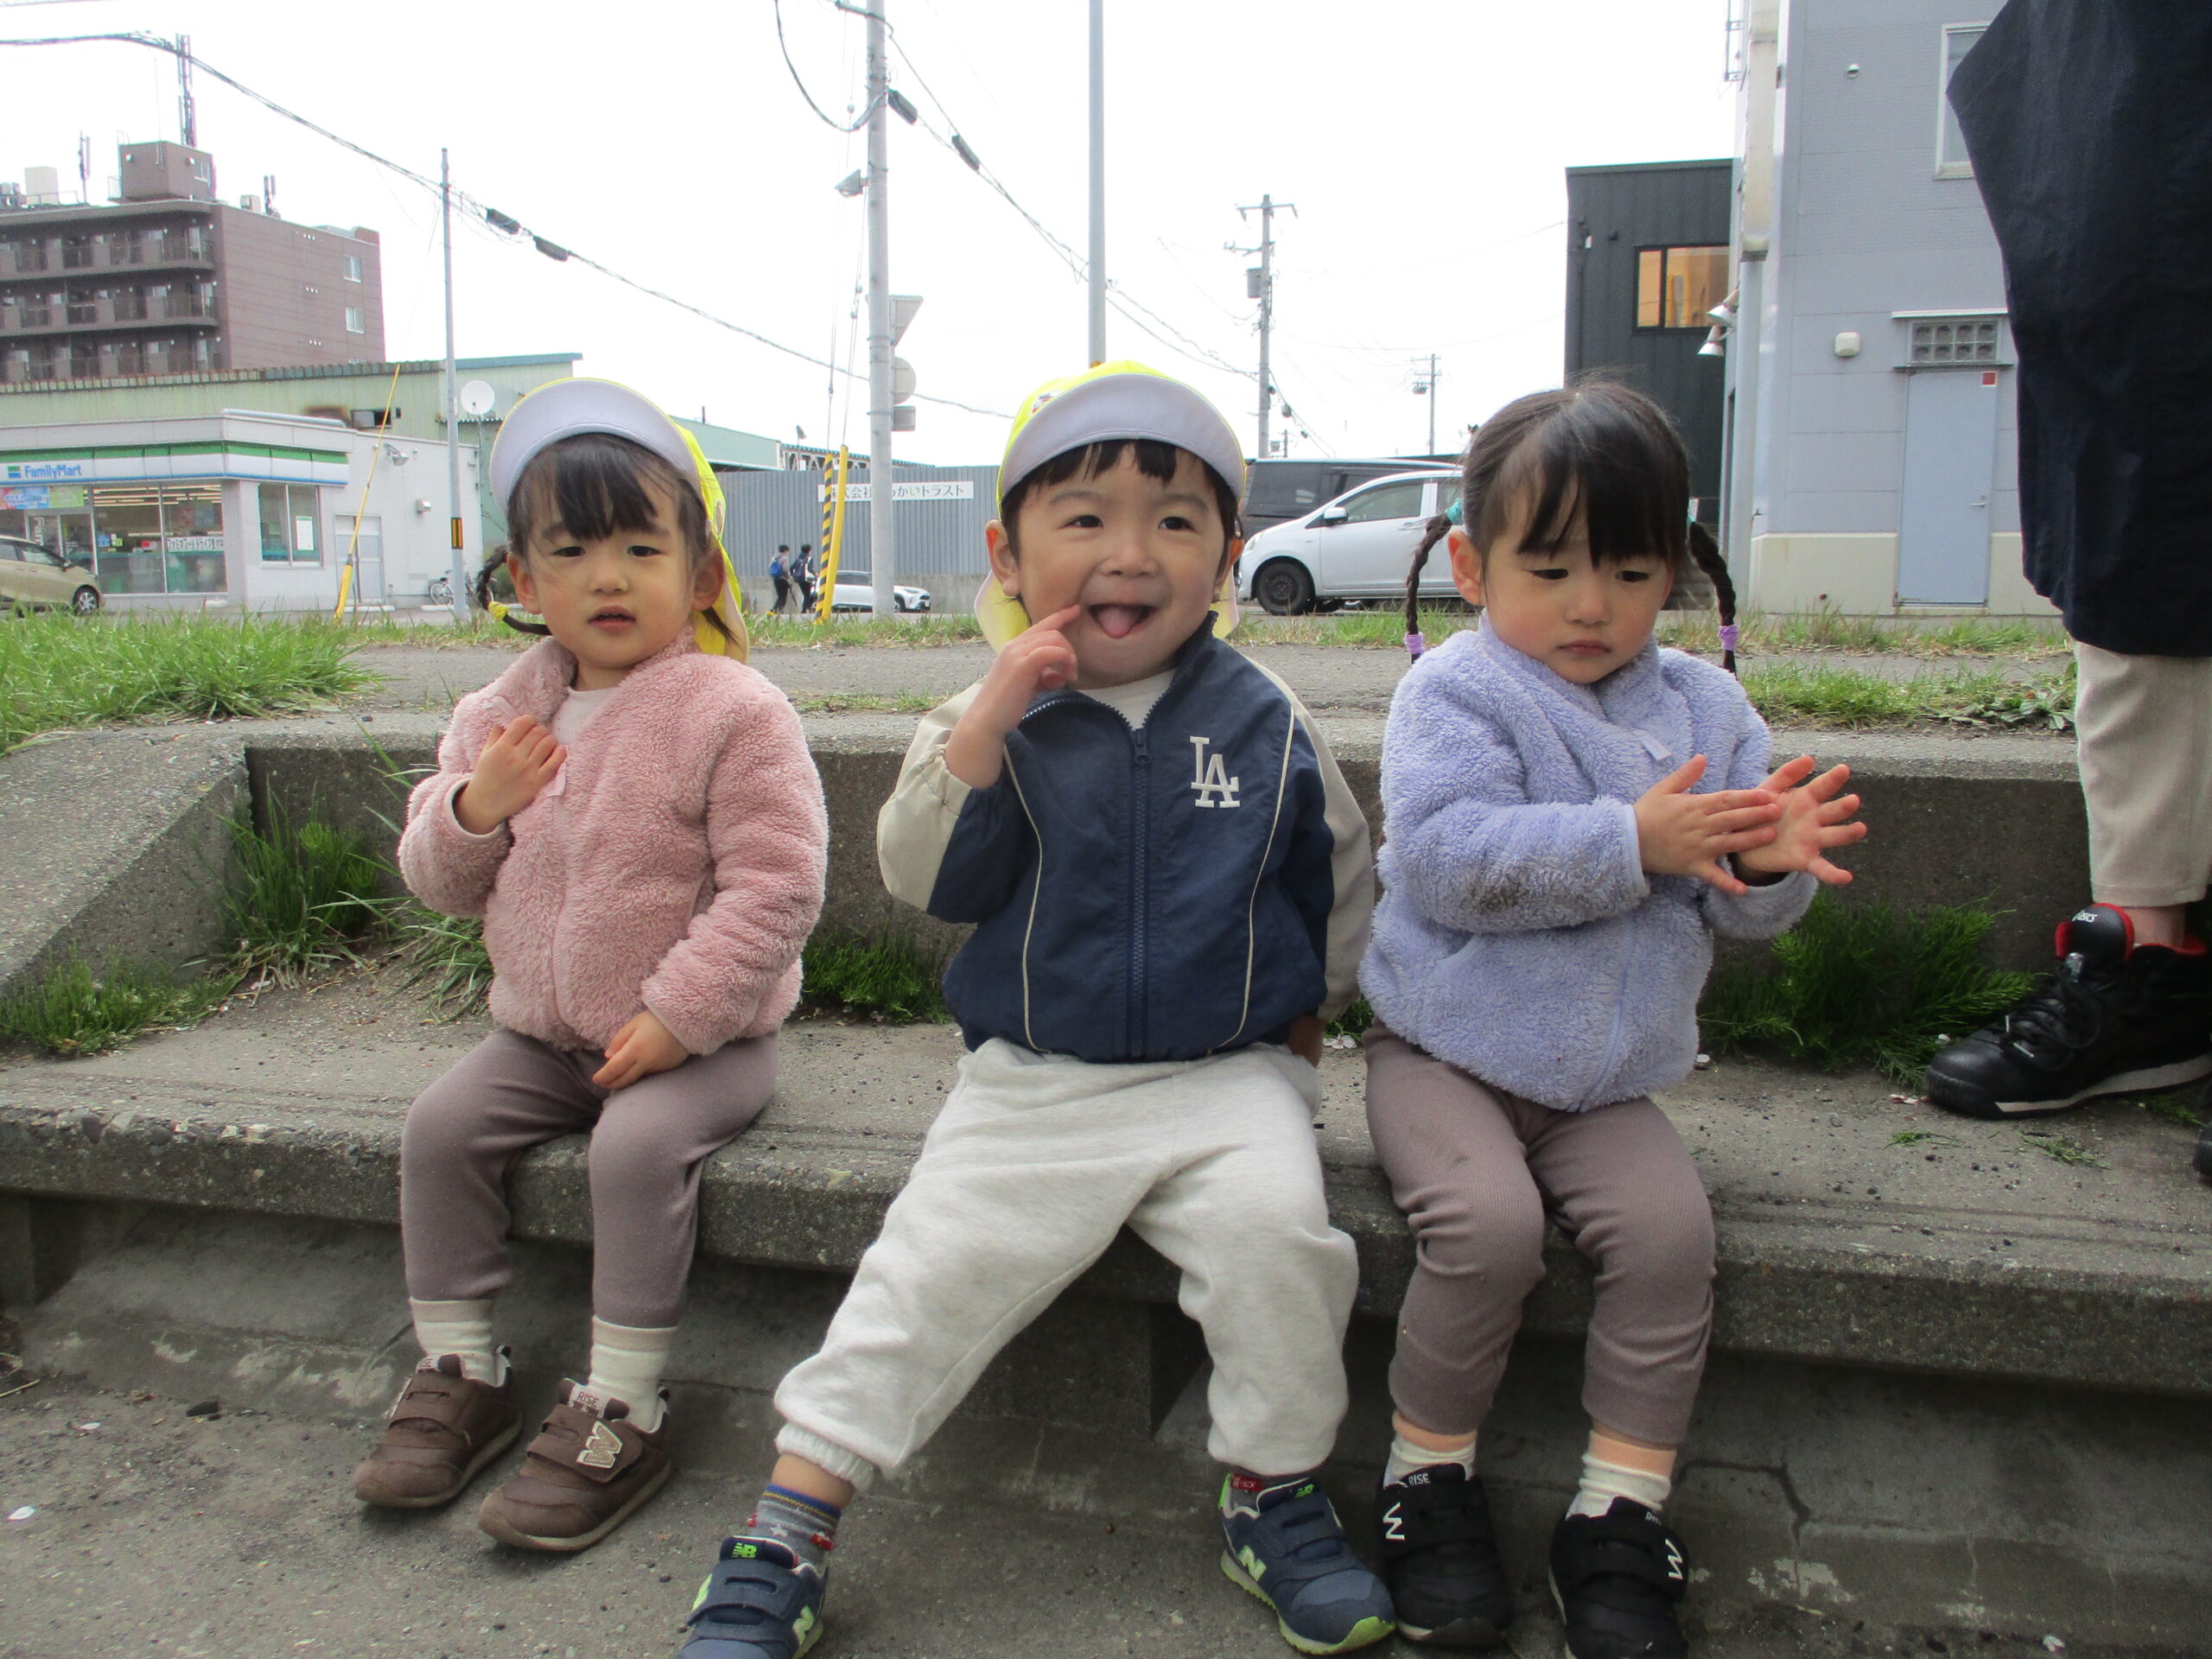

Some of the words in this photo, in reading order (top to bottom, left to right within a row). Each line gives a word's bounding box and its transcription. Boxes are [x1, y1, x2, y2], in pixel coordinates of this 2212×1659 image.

[24, 464, 82, 478] FamilyMart
[1189, 735, 1241, 809] LA
[577, 1391, 600, 1408] RISE
[1408, 1472, 1431, 1485] RISE
